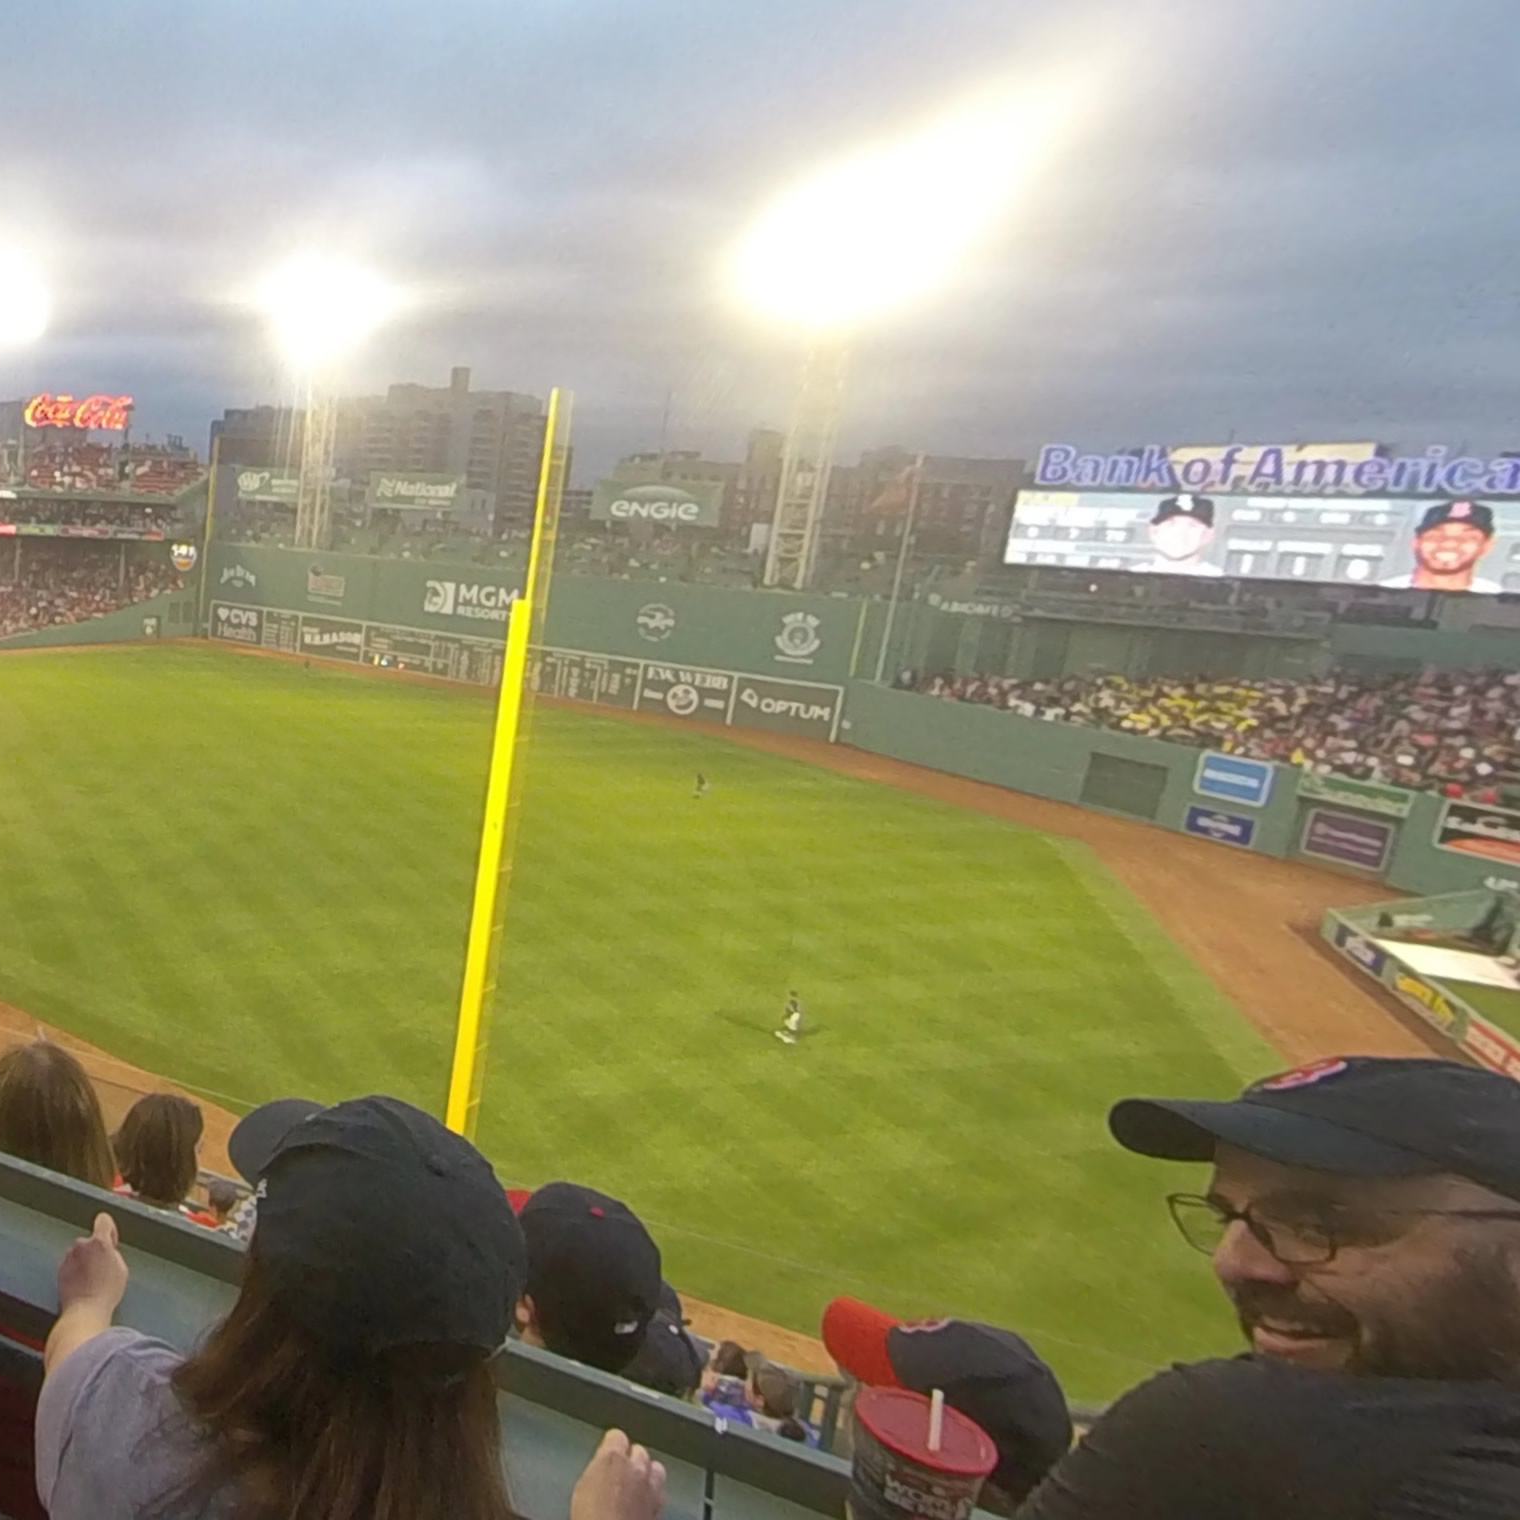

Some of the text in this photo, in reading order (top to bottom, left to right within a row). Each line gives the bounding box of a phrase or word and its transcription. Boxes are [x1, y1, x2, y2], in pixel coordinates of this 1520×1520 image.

[1035, 444, 1520, 496] Bank of America
[395, 480, 458, 498] National
[458, 583, 520, 608] MGM
[231, 608, 258, 627] CVS
[457, 605, 512, 621] RESORT
[217, 622, 257, 642] Health
[760, 698, 831, 722] OPTUM
